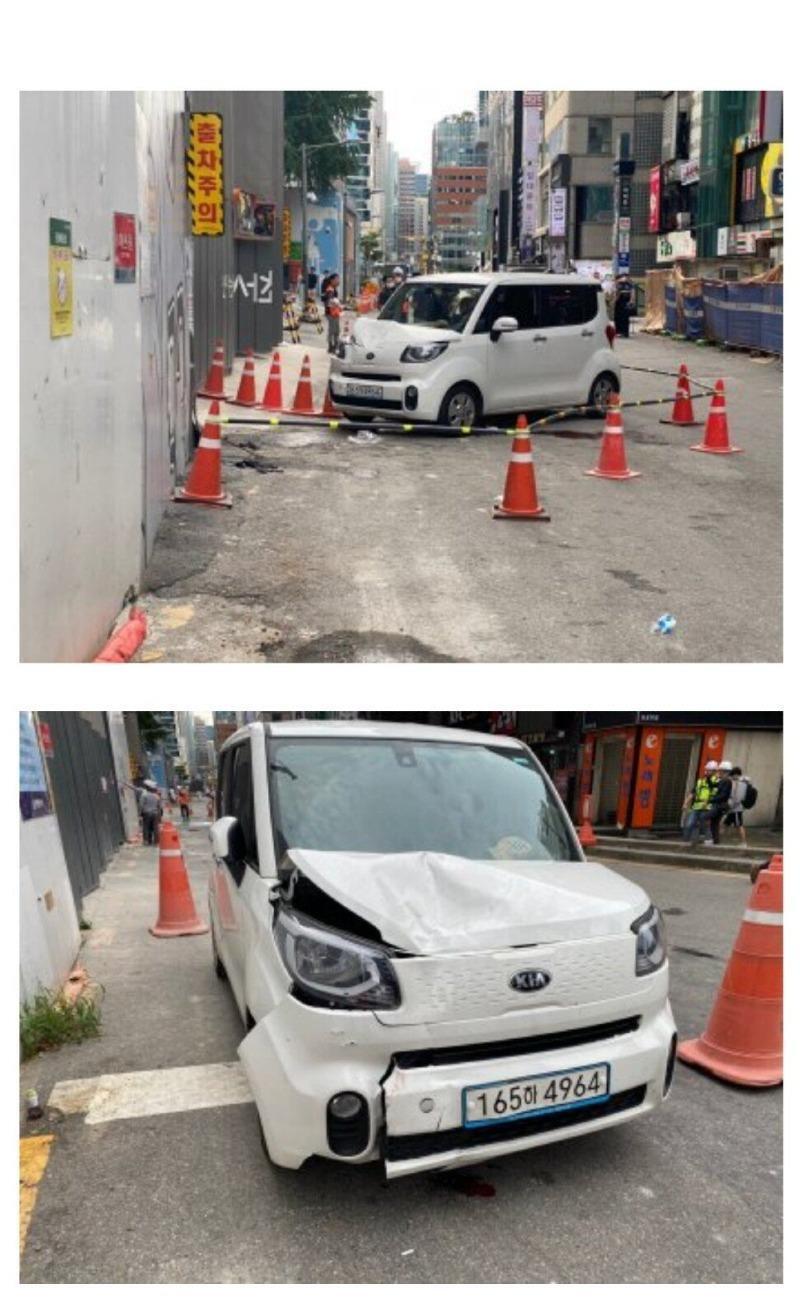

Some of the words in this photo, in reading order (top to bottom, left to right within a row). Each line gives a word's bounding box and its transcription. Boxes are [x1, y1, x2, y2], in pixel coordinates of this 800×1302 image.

[515, 972, 546, 988] KIA
[477, 1084, 538, 1116] 165하
[543, 1071, 601, 1103] 4964
